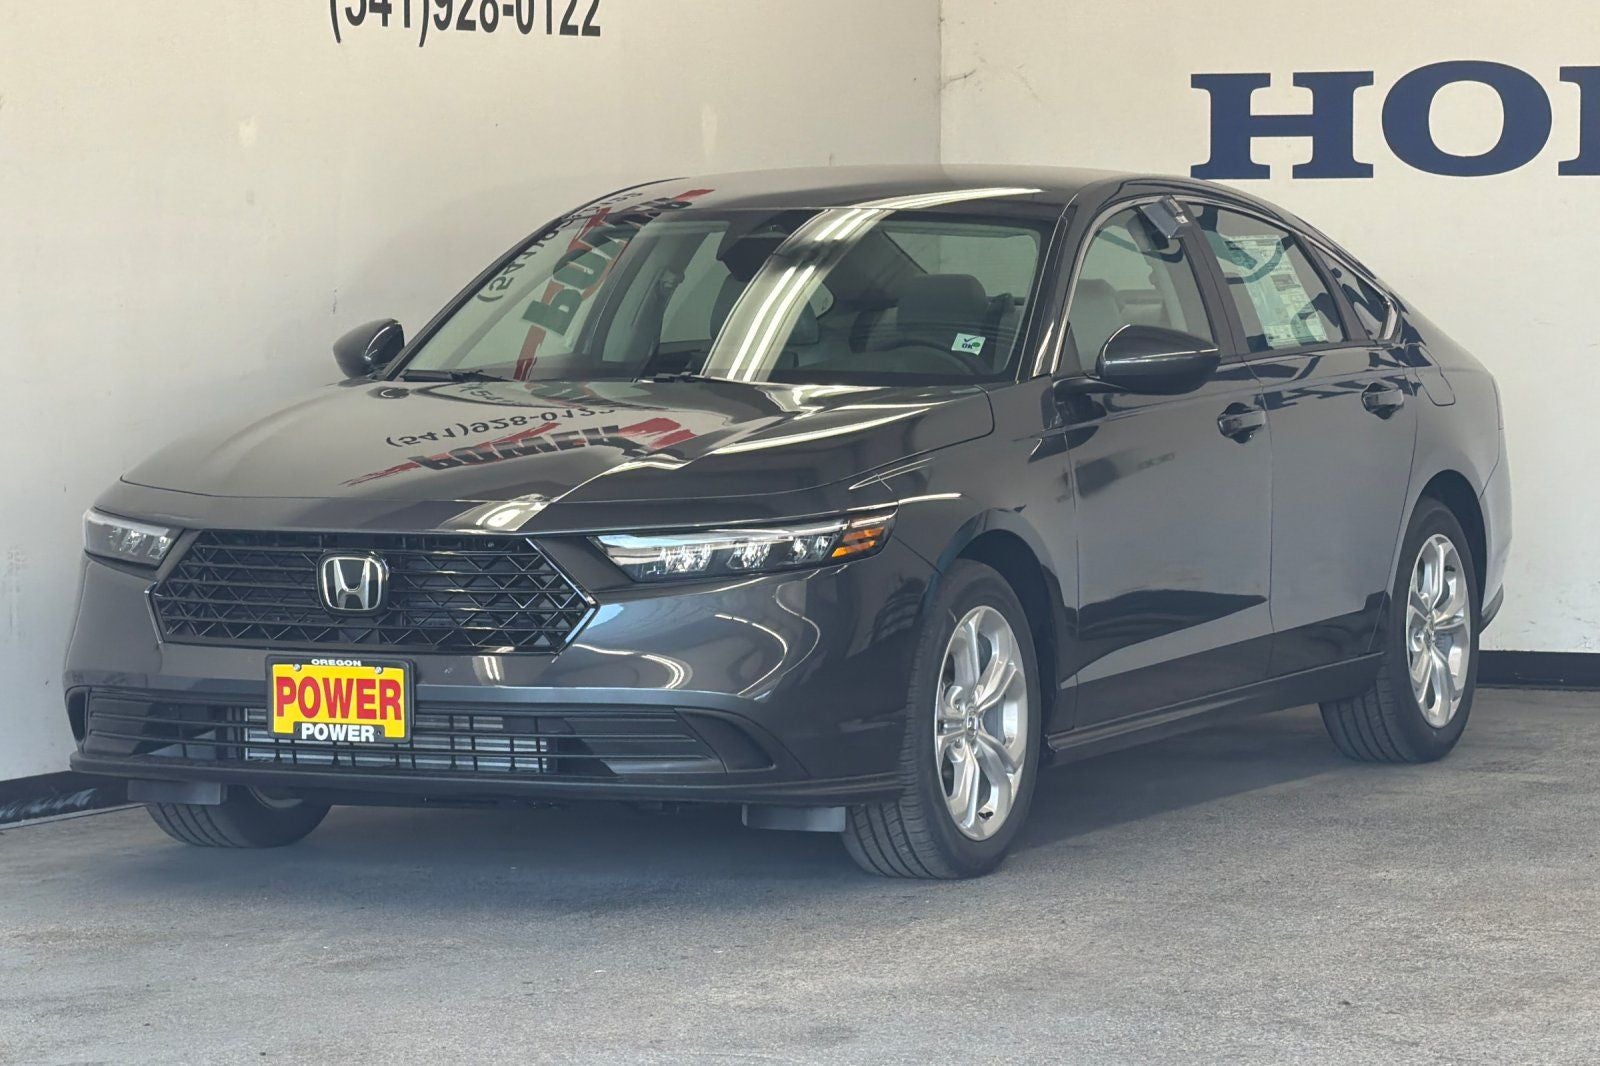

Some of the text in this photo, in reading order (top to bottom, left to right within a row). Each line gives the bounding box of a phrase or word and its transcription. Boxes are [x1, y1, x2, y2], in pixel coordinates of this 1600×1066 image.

[1190, 60, 1600, 179] HO
[311, 658, 362, 667] OREGON
[276, 676, 402, 720] POWER
[301, 723, 375, 742] POWER
